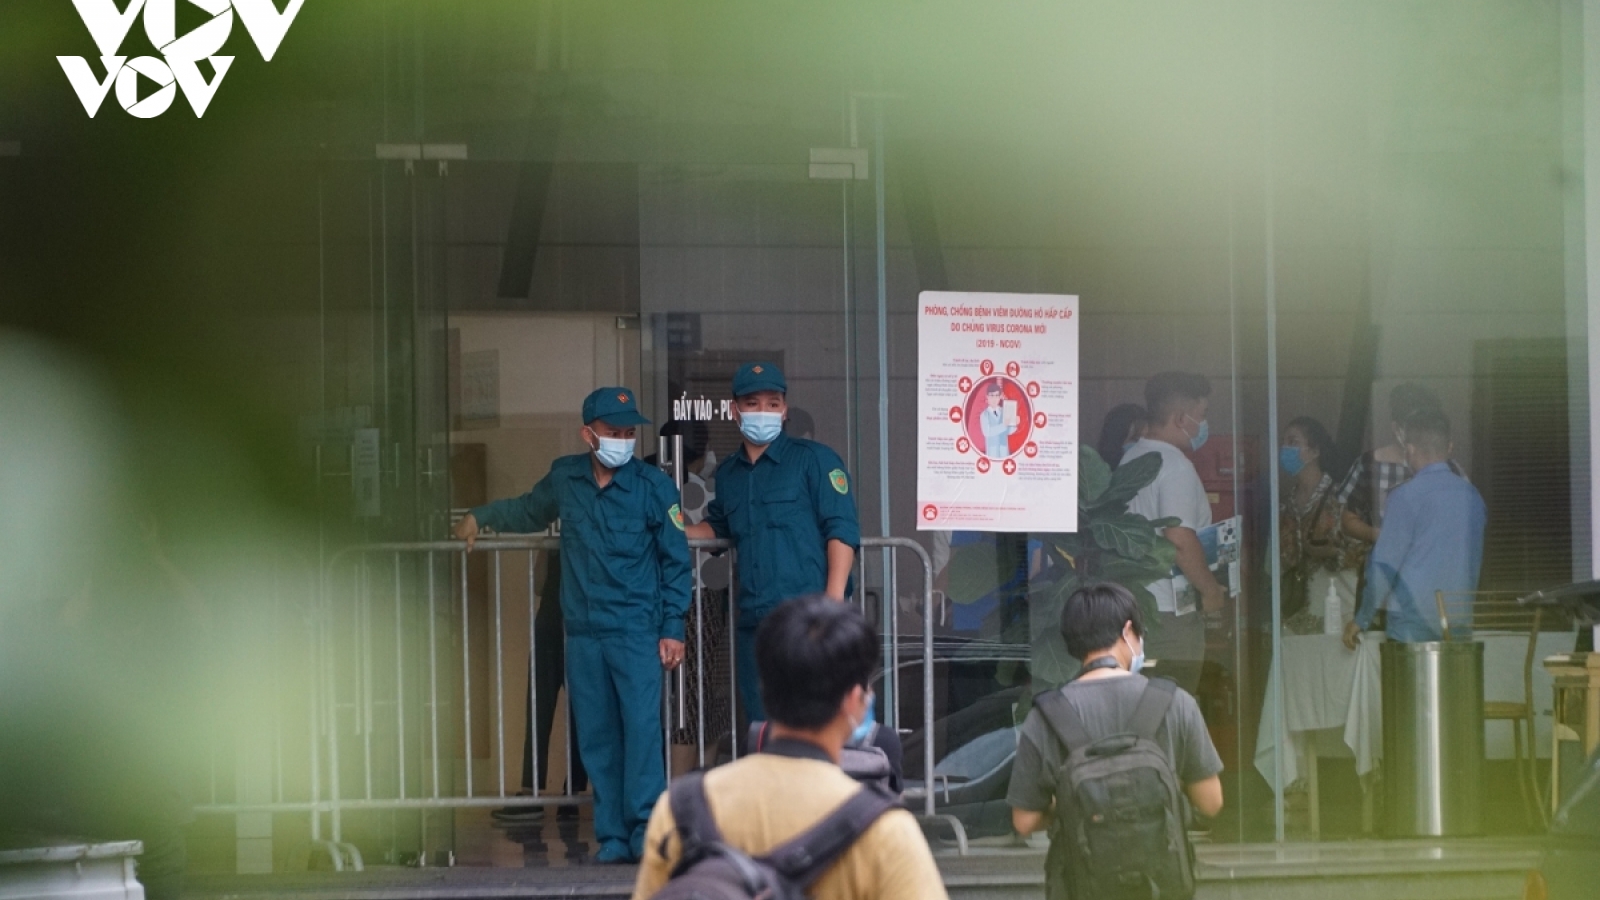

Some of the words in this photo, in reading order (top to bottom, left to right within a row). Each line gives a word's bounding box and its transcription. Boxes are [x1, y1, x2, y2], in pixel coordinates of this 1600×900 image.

[925, 304, 948, 316] PHÒNG,
[950, 303, 973, 316] CHỐNG
[975, 305, 991, 319] BỆNH
[993, 305, 1008, 317] VIÊM
[1034, 306, 1043, 318] HÔ
[1045, 305, 1057, 319] HẤP
[1059, 306, 1072, 319] CẤP
[951, 322, 960, 332] DO
[986, 323, 1005, 333] VIRUS
[1006, 323, 1032, 334] CORONA
[673, 390, 692, 421] ĐẨY
[694, 395, 713, 421] VÀO
[720, 399, 733, 421] PU
